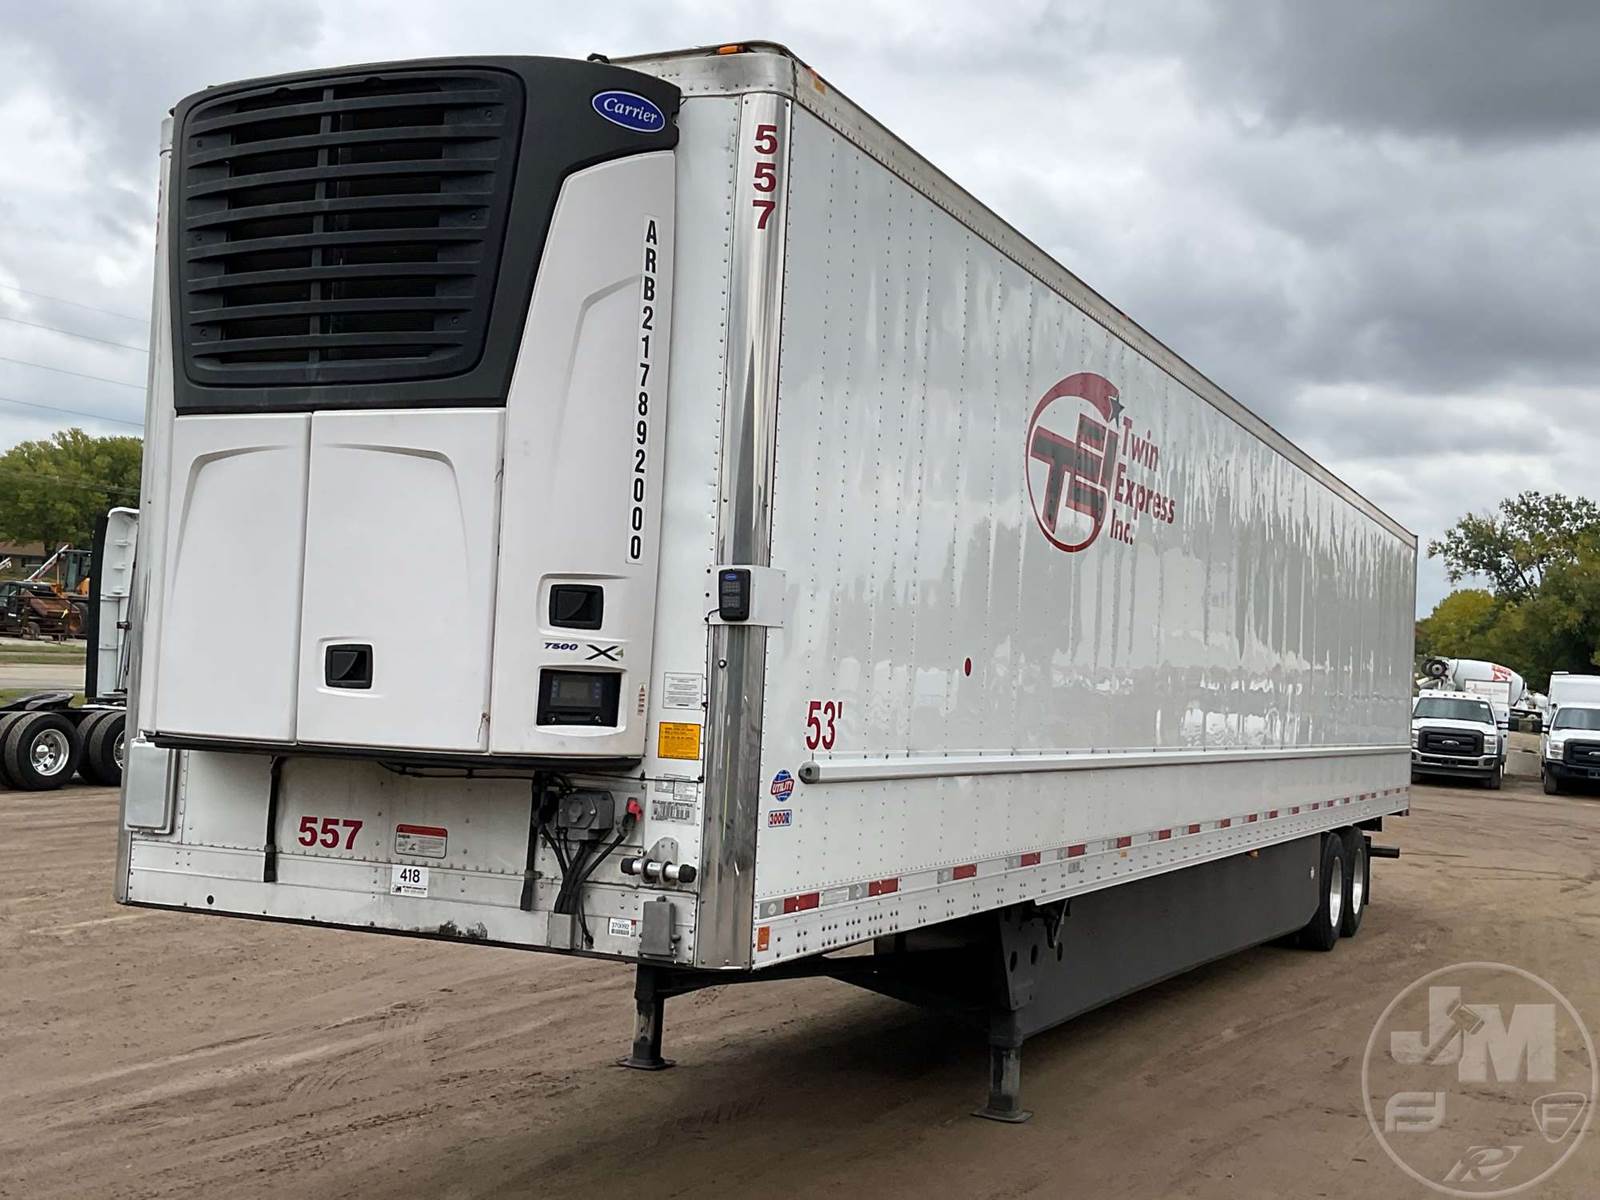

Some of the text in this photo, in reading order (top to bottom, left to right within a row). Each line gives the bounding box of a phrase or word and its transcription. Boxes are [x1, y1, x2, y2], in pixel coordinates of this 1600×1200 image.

[603, 97, 658, 124] Carrier
[752, 124, 778, 230] 557
[630, 219, 658, 560] ARB217892000
[1121, 416, 1160, 472] Twin
[1114, 463, 1176, 524] Express
[1109, 509, 1134, 545] Inc.
[544, 642, 579, 651] 7500
[771, 781, 793, 793] UTILITY
[298, 816, 363, 849] 557
[769, 812, 790, 825] 3000R
[399, 868, 421, 883] 418
